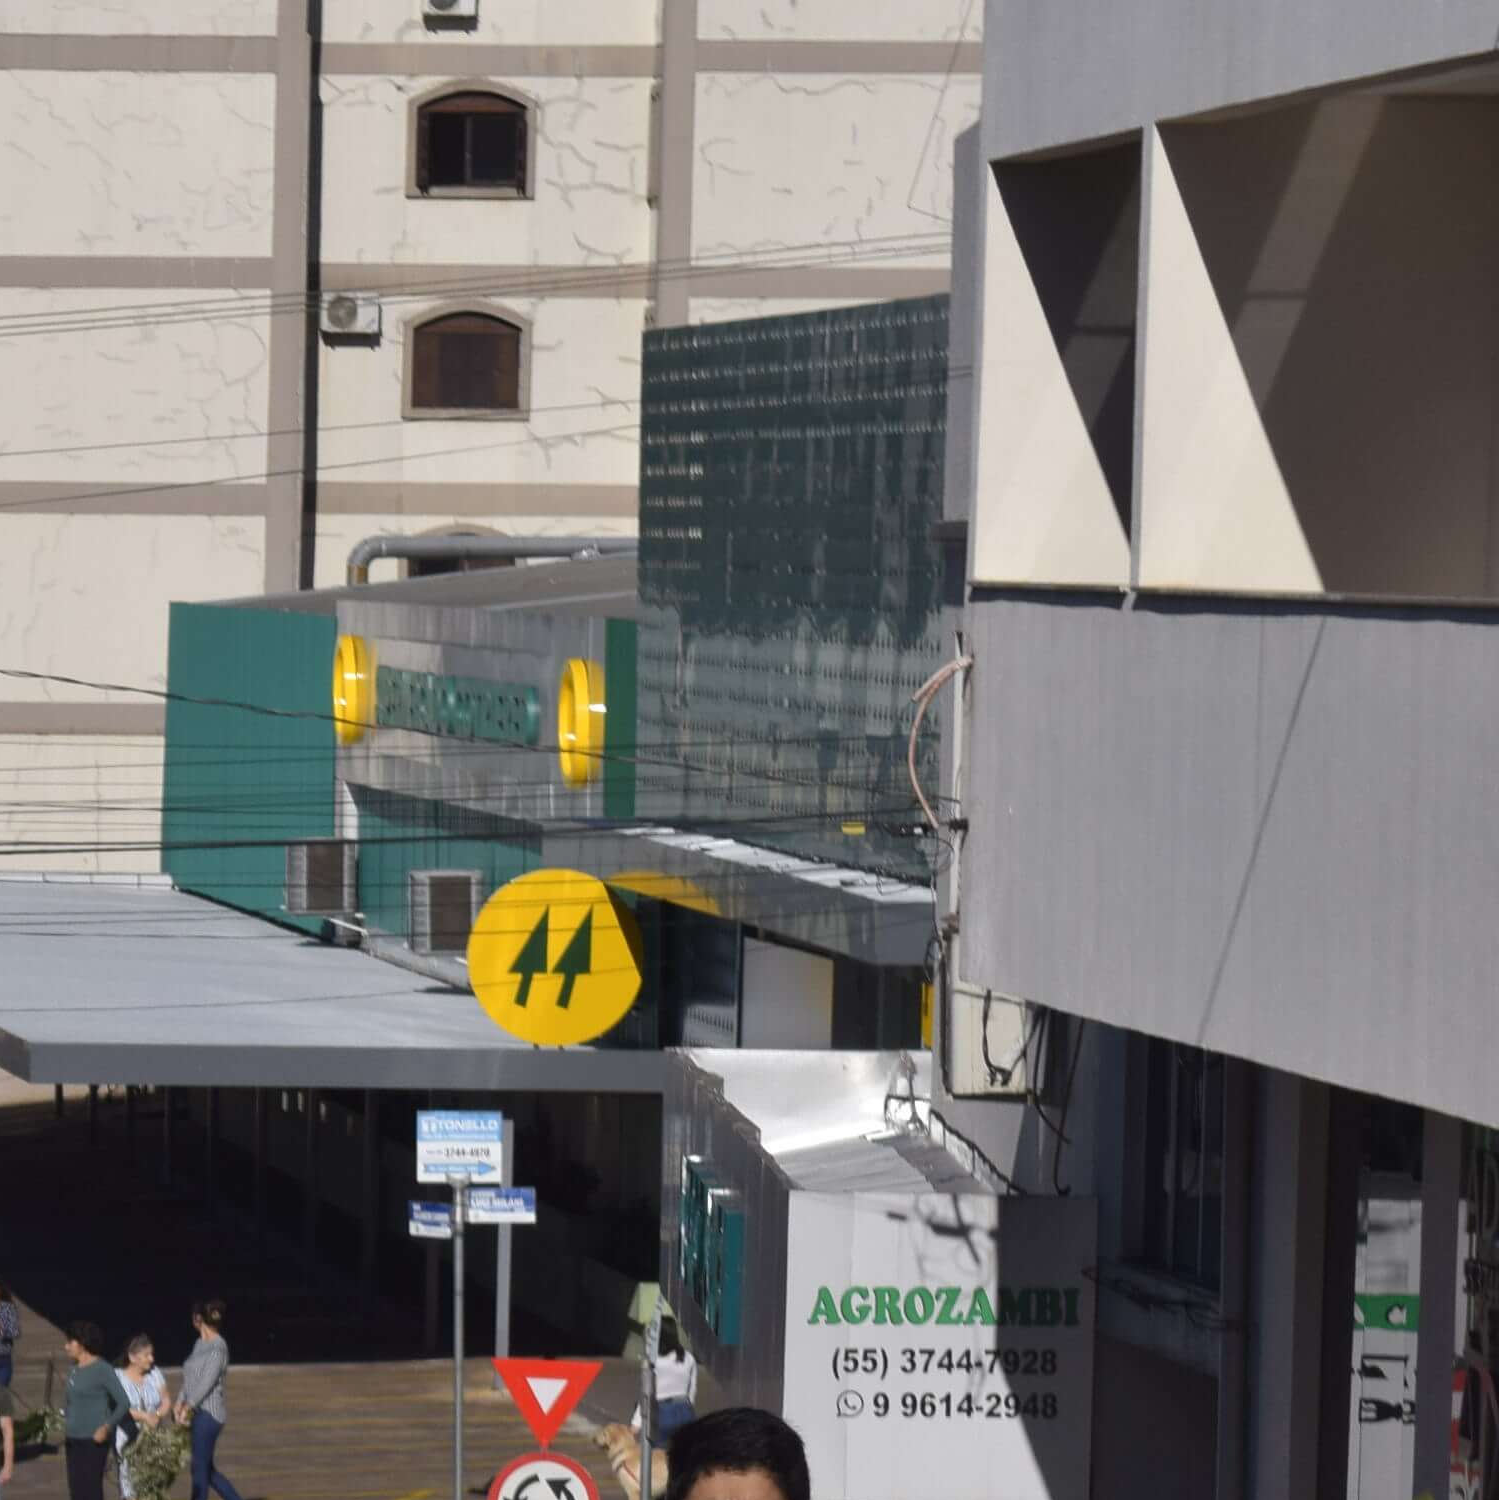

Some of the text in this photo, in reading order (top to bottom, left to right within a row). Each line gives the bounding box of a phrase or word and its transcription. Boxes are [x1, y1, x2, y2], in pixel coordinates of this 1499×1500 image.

[807, 1285, 1080, 1326] AGROZAMBI
[831, 1347, 1058, 1380] (55) 3744-7928
[872, 1391, 1059, 1419] 9 9614-2948
